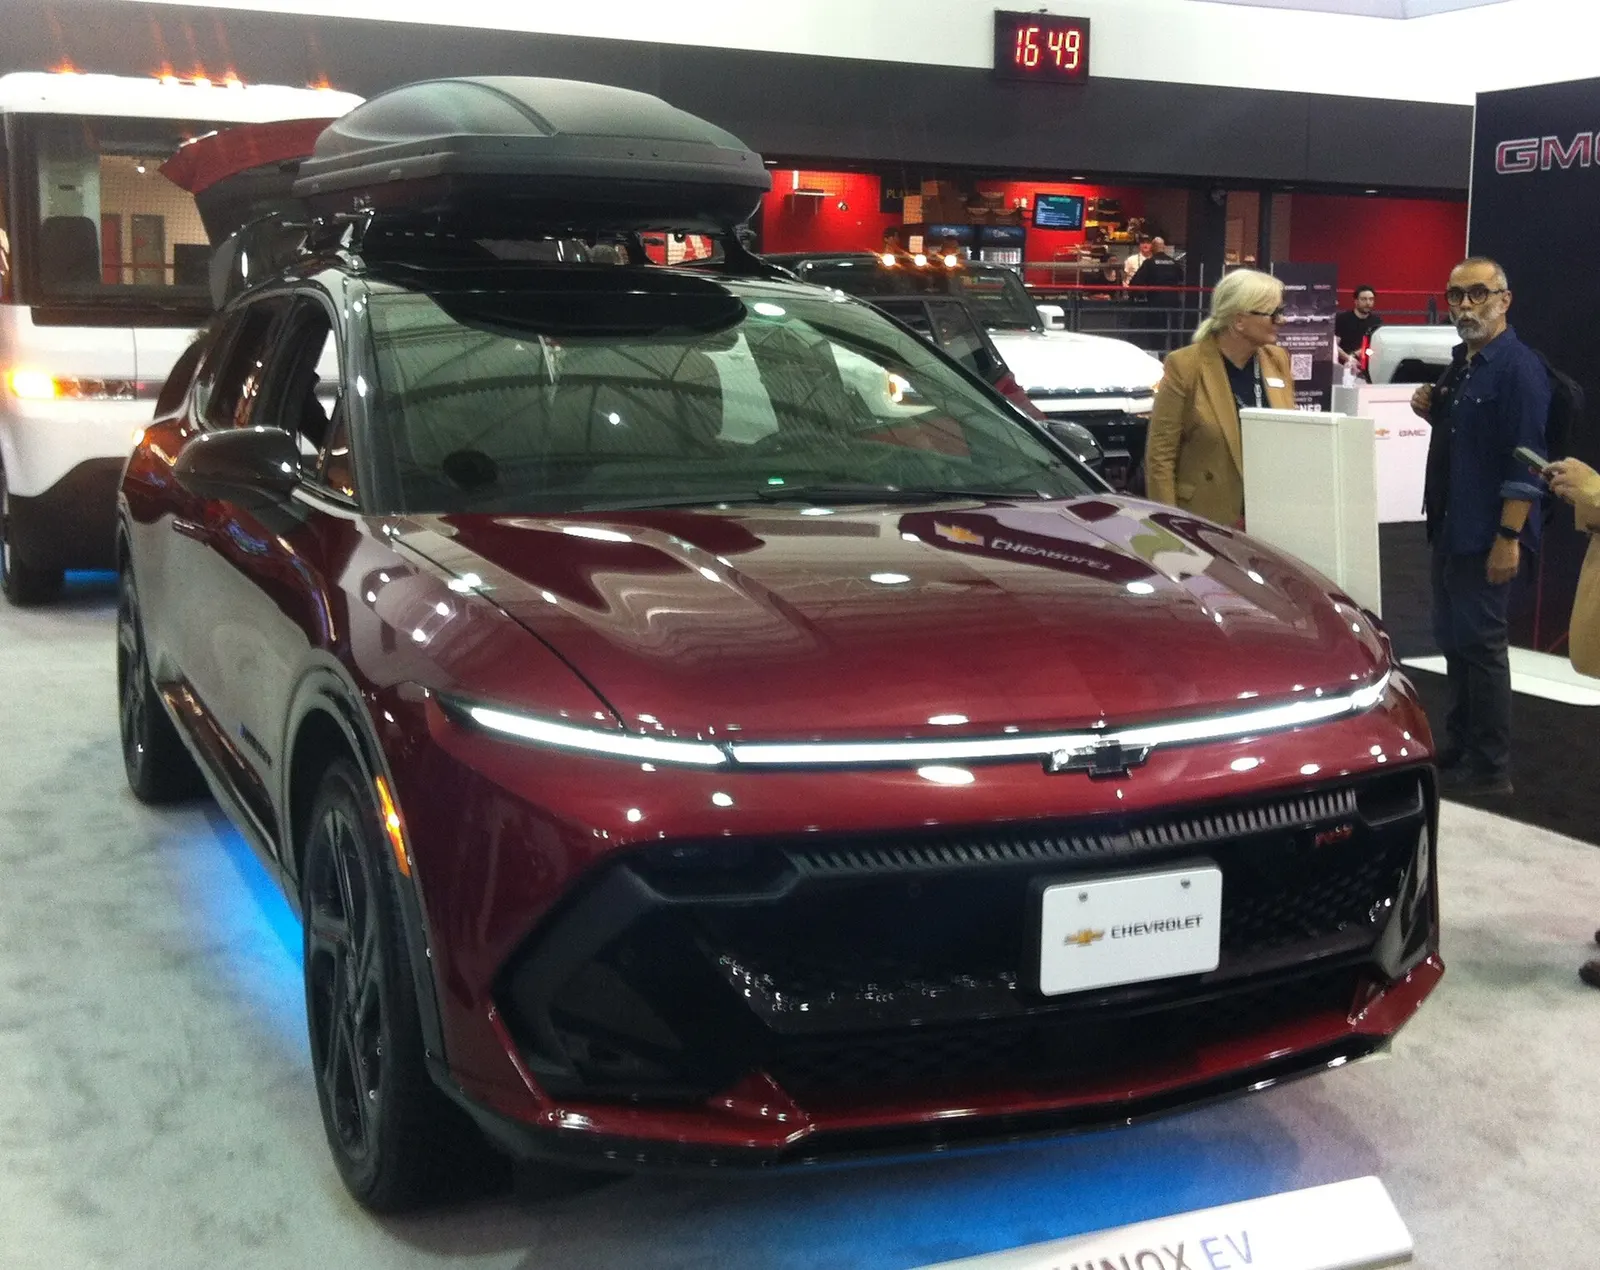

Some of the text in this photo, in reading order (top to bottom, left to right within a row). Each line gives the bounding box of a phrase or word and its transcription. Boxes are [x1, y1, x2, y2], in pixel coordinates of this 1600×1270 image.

[1016, 27, 1080, 69] 16 49
[1495, 131, 1600, 175] GM
[1398, 429, 1426, 437] GMC
[1110, 914, 1204, 940] CHEVROLET
[1200, 1230, 1253, 1270] EV
